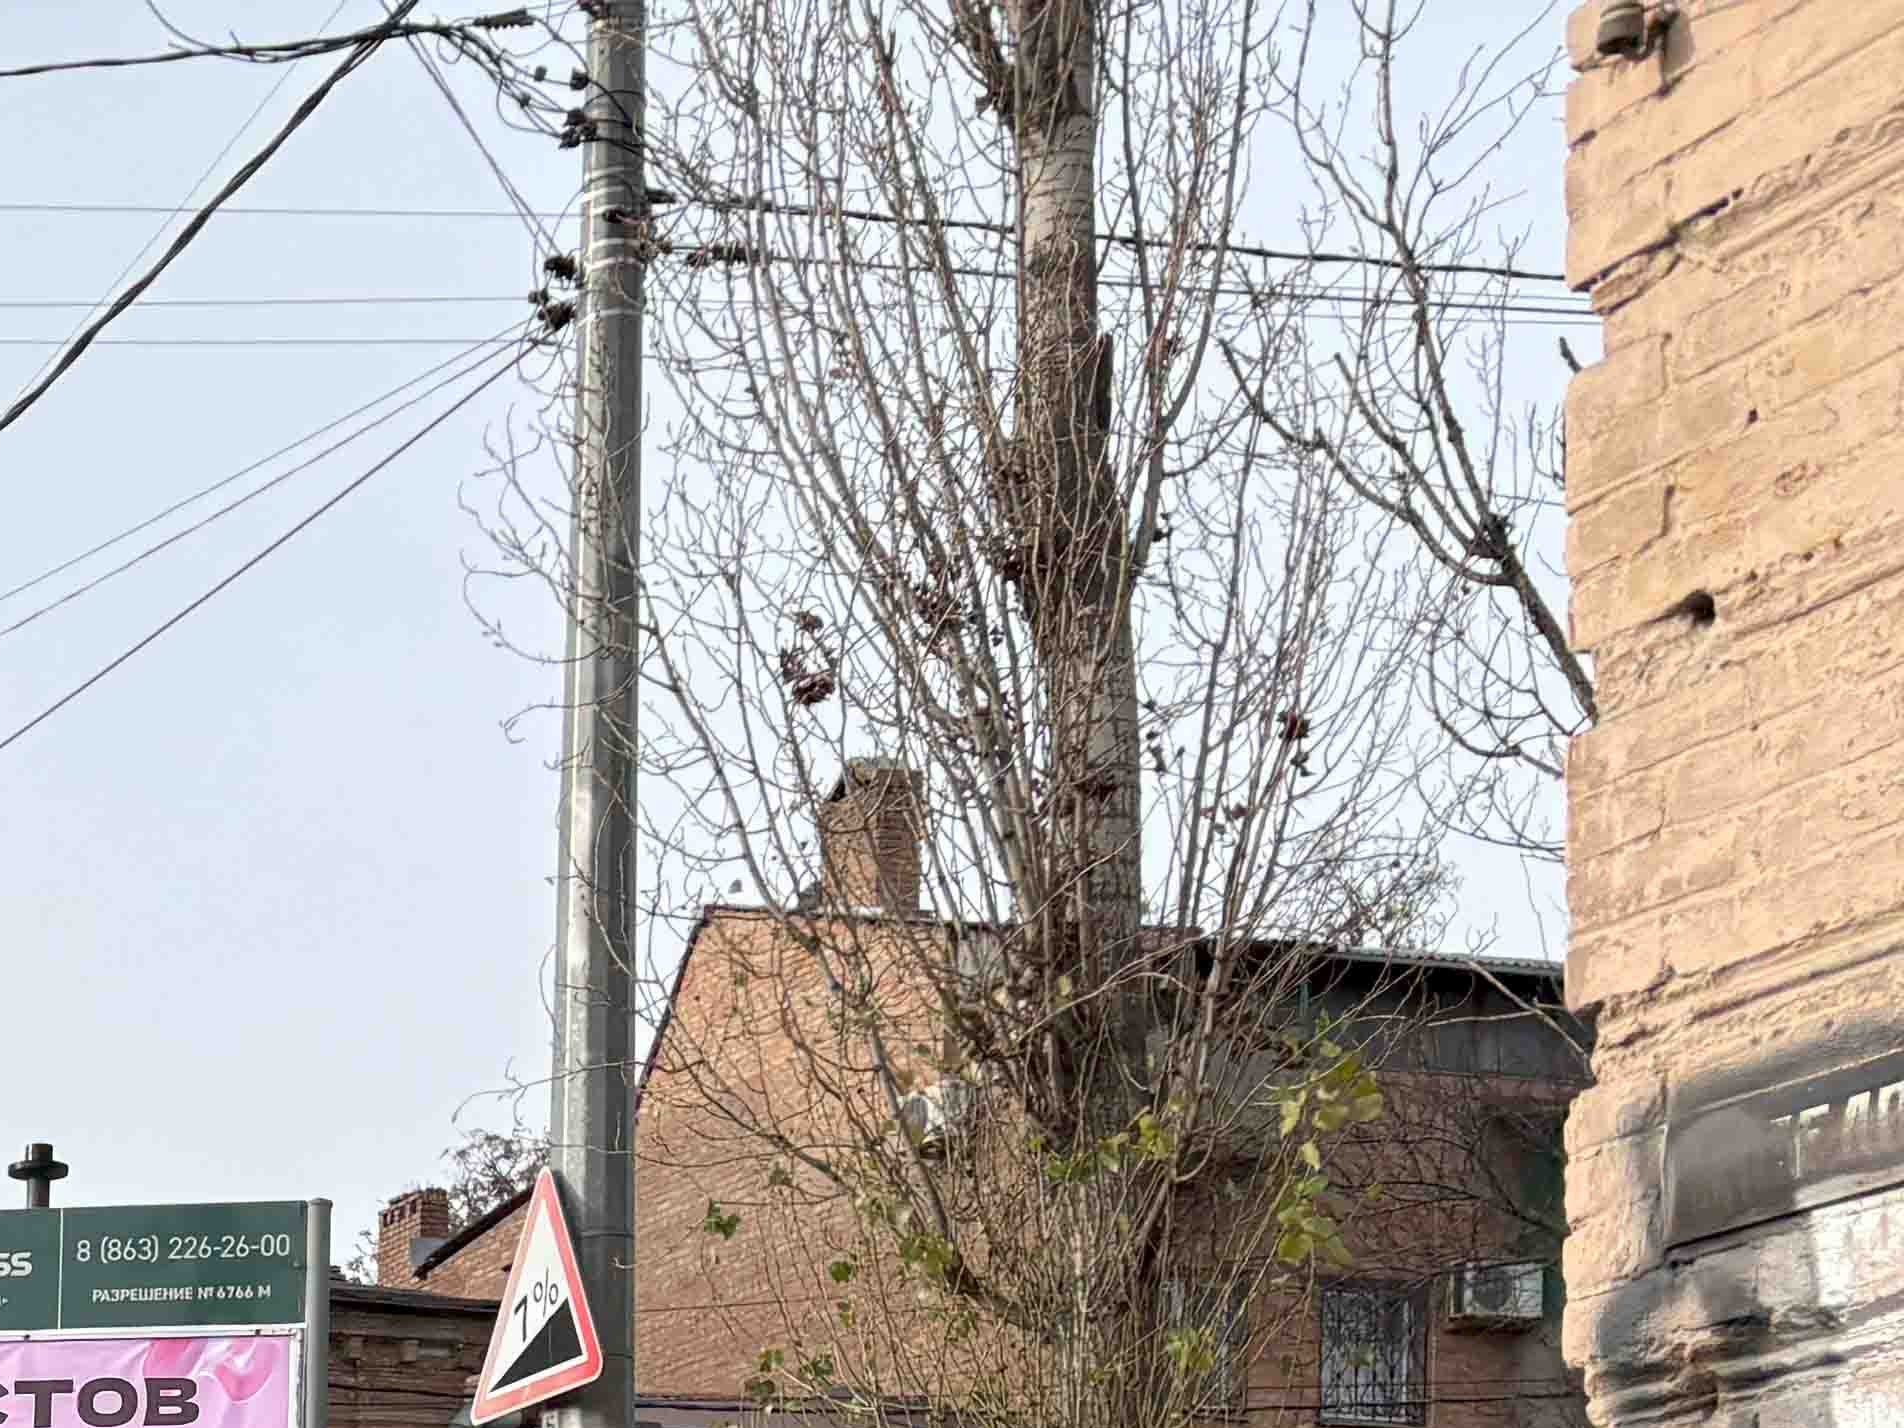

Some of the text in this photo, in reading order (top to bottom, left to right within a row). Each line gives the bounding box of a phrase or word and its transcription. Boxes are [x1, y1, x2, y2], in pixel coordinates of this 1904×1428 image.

[76, 1234, 290, 1263] 8 (863) 226-26-00
[92, 1287, 193, 1303] РАЗРЕШЕНИЕ
